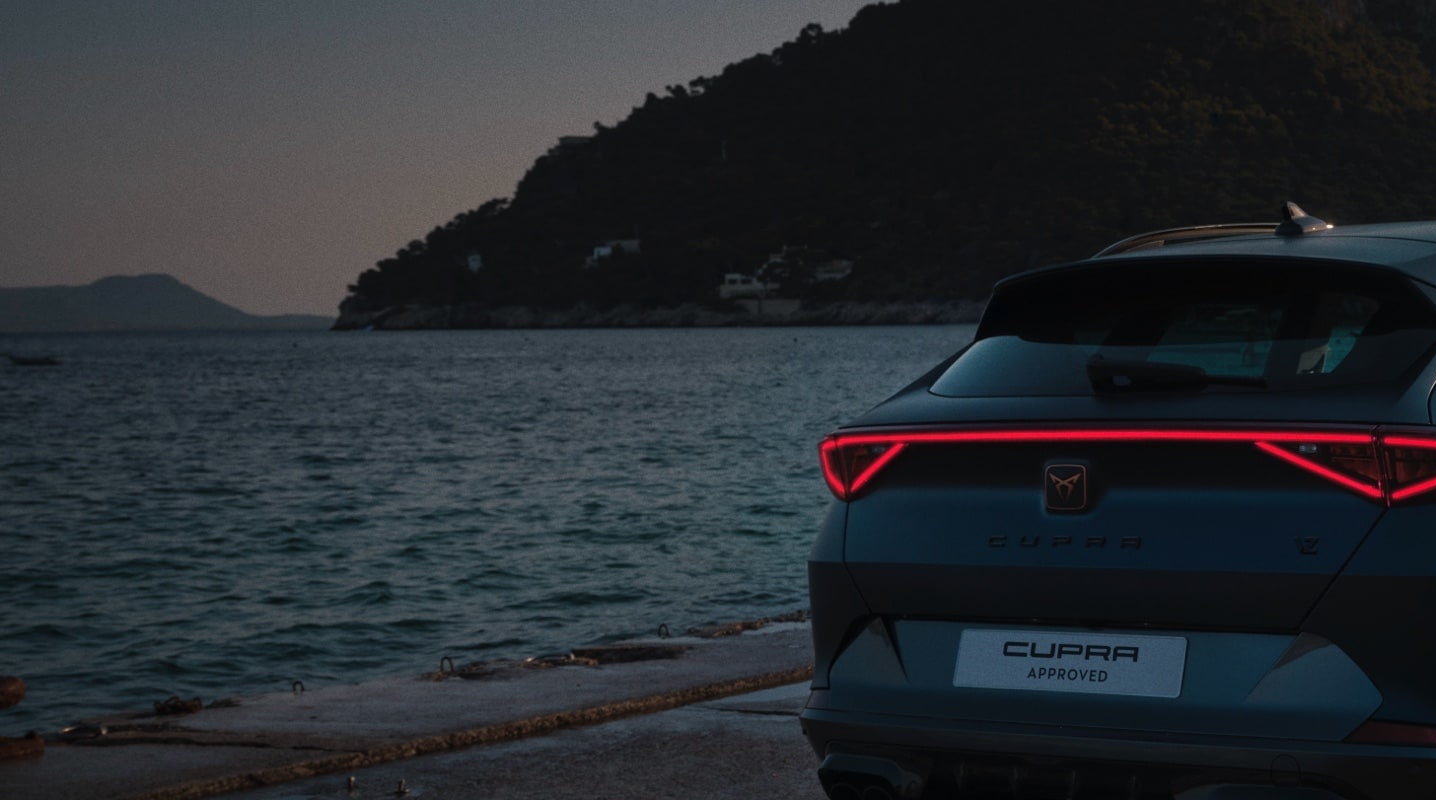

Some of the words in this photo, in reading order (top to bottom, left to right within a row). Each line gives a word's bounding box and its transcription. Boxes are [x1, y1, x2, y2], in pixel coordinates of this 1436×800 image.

[989, 534, 1143, 551] CUPRA
[1002, 641, 1139, 663] CUPRA
[1027, 667, 1108, 683] APPROVED
